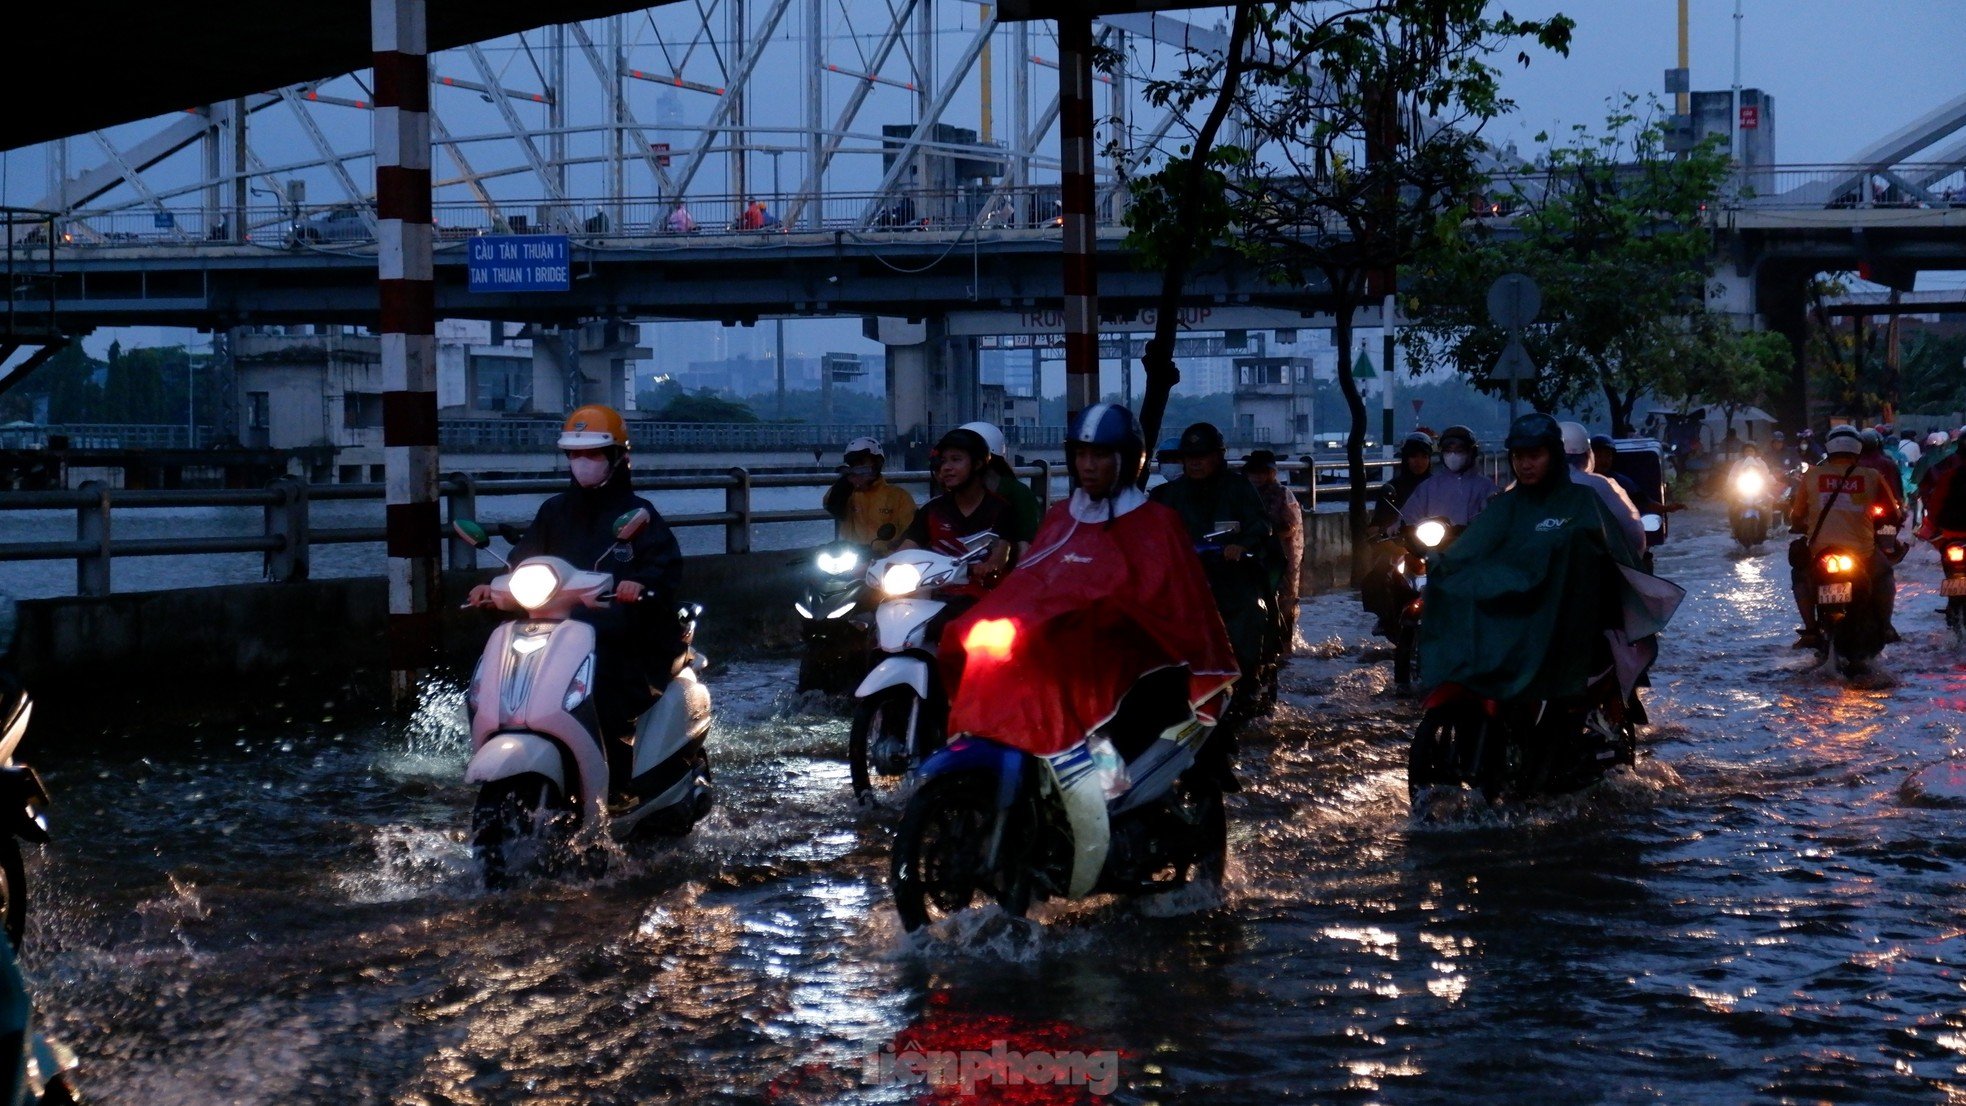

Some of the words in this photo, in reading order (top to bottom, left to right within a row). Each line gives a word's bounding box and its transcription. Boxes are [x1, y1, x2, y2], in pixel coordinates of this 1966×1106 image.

[475, 239, 494, 260] CẦU
[499, 242, 518, 259] TÂN
[523, 241, 554, 262] THUẬN
[558, 243, 563, 259] 1
[470, 268, 488, 284] TAN
[493, 267, 522, 283] THUAN
[526, 268, 531, 283] 1
[535, 267, 566, 283] BRIDGE
